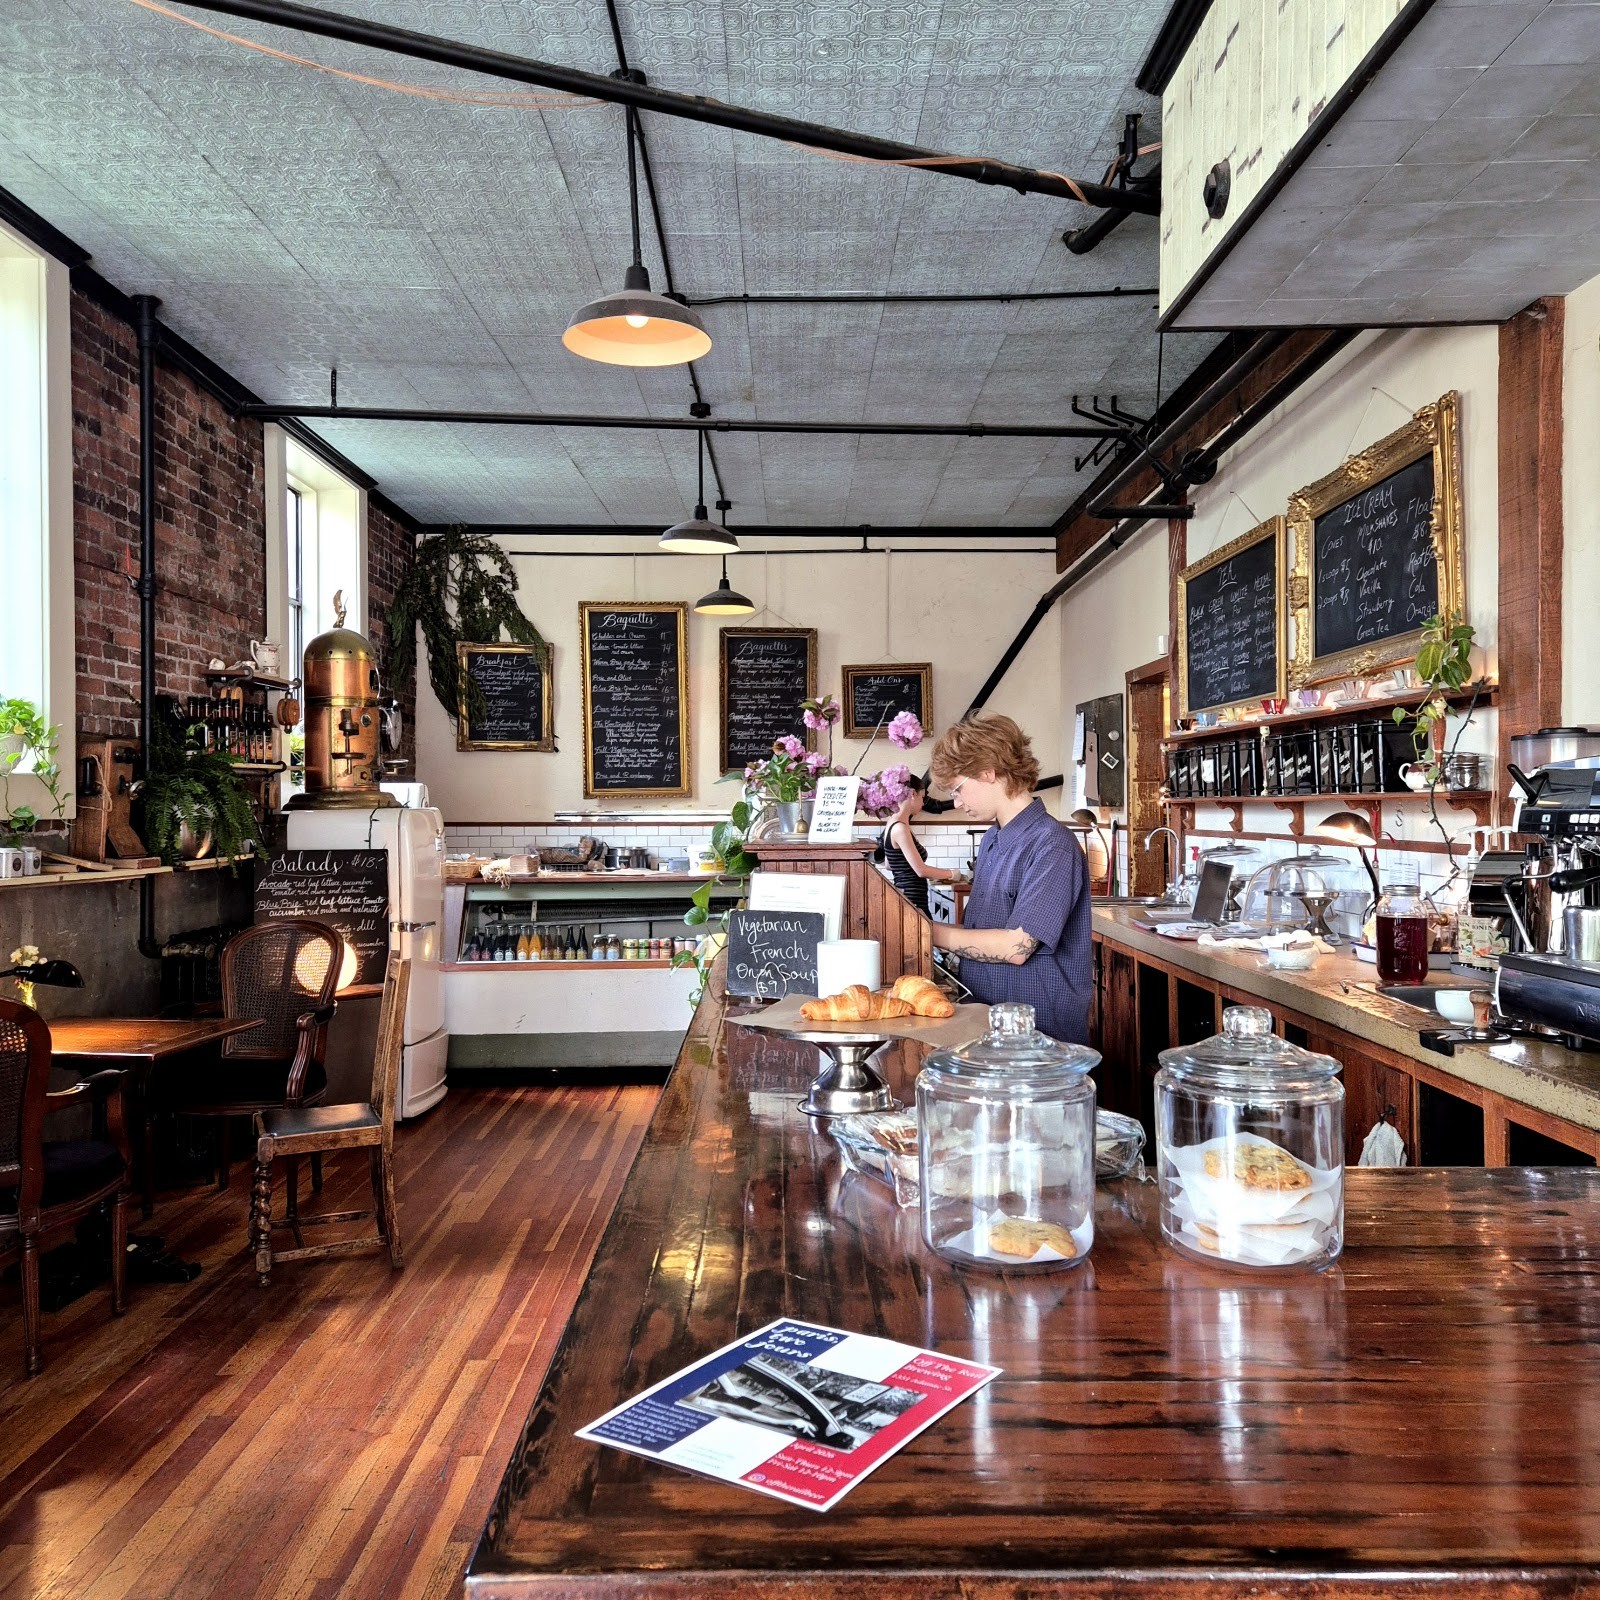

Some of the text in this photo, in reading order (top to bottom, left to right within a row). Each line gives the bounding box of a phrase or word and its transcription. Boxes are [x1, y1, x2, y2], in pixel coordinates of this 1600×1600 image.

[1364, 485, 1394, 518] CREAM
[1357, 557, 1388, 581] Chocolate
[1409, 573, 1426, 598] Cola
[1406, 601, 1436, 622] Orange
[598, 613, 657, 630] Baguettes
[1376, 619, 1389, 634] Tea
[736, 641, 792, 656] Baguettes
[475, 654, 523, 669] Breakfast
[271, 851, 344, 876] Salads
[256, 878, 291, 892] Avocado
[308, 879, 320, 890] leaf
[342, 877, 373, 886] cucumber
[342, 885, 366, 893] walnuts
[255, 899, 279, 912] Blue
[305, 897, 318, 906] red
[320, 896, 335, 909] leaf
[308, 907, 319, 915] red
[320, 906, 338, 914] onion
[353, 905, 382, 914] walnuts
[357, 919, 377, 932] dill
[738, 916, 807, 945] Vegetarian
[751, 940, 809, 963] French
[779, 964, 818, 984] Soup
[758, 981, 777, 993] $9
[769, 1333, 805, 1345] two
[745, 1339, 812, 1358] jours
[904, 1364, 952, 1381] Brewing
[935, 1364, 957, 1372] The
